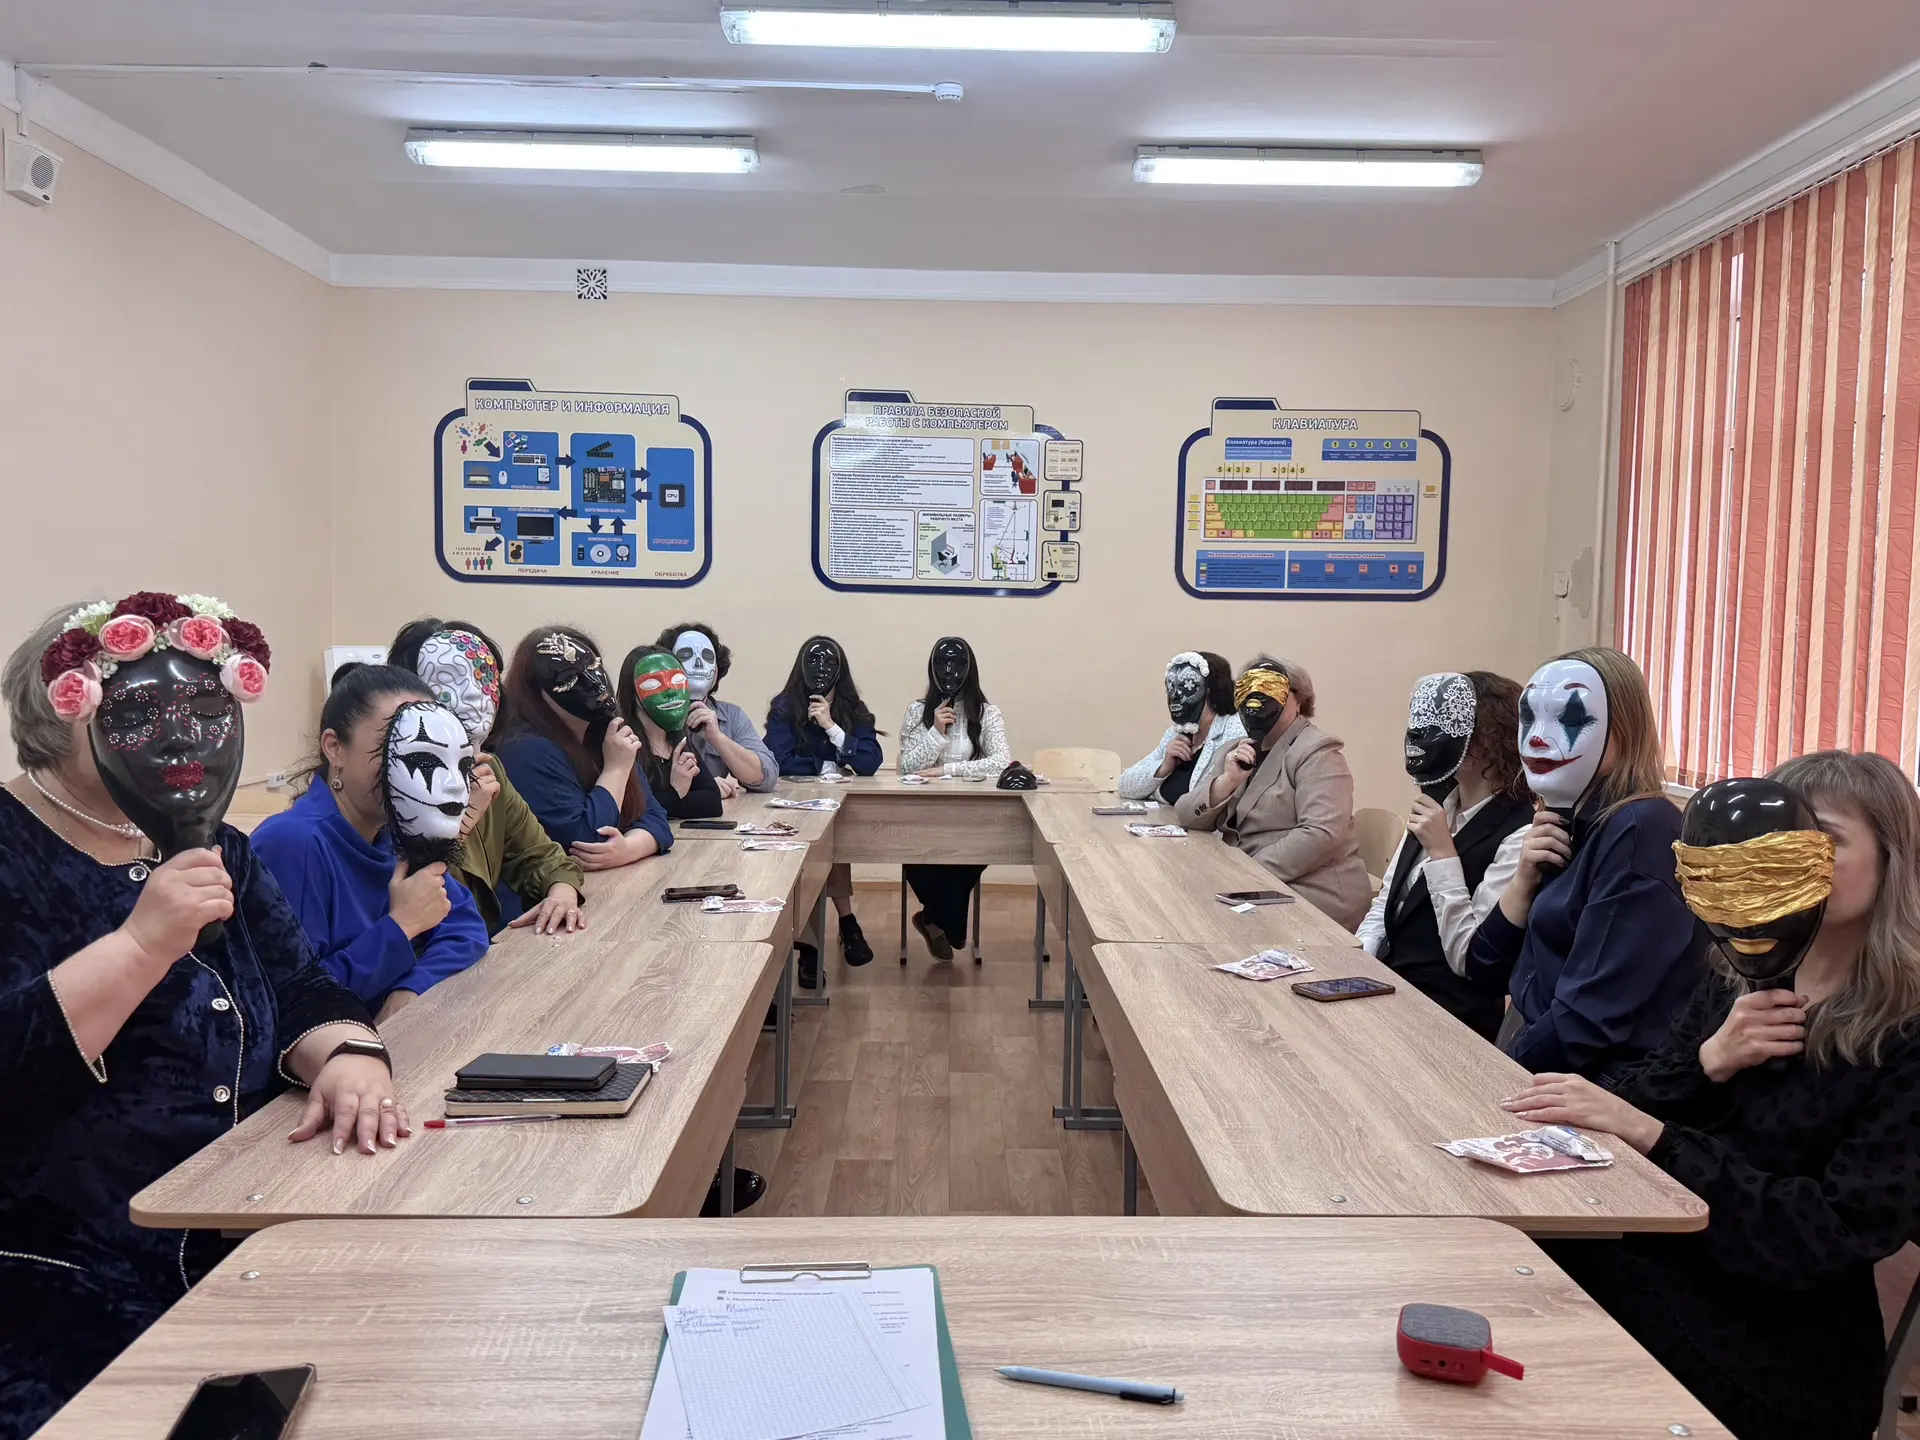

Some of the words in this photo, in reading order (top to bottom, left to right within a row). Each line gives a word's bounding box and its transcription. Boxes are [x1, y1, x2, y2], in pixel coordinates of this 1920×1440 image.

[475, 397, 558, 411] КОМПЬЮТЕР
[561, 400, 571, 412] И
[574, 401, 670, 416] ИНФОРМАЦИЯ
[874, 404, 925, 416] ПРАВИЛА
[927, 405, 1001, 419] БЕЗОПАСНОЙ
[865, 416, 910, 428] РАБОТЫ
[912, 417, 921, 429] С
[922, 418, 1009, 431] КОМПЬЮТЕРОМ
[1272, 417, 1359, 430] КЛАВИАТУРА
[1258, 439, 1287, 447] (Keyboard)
